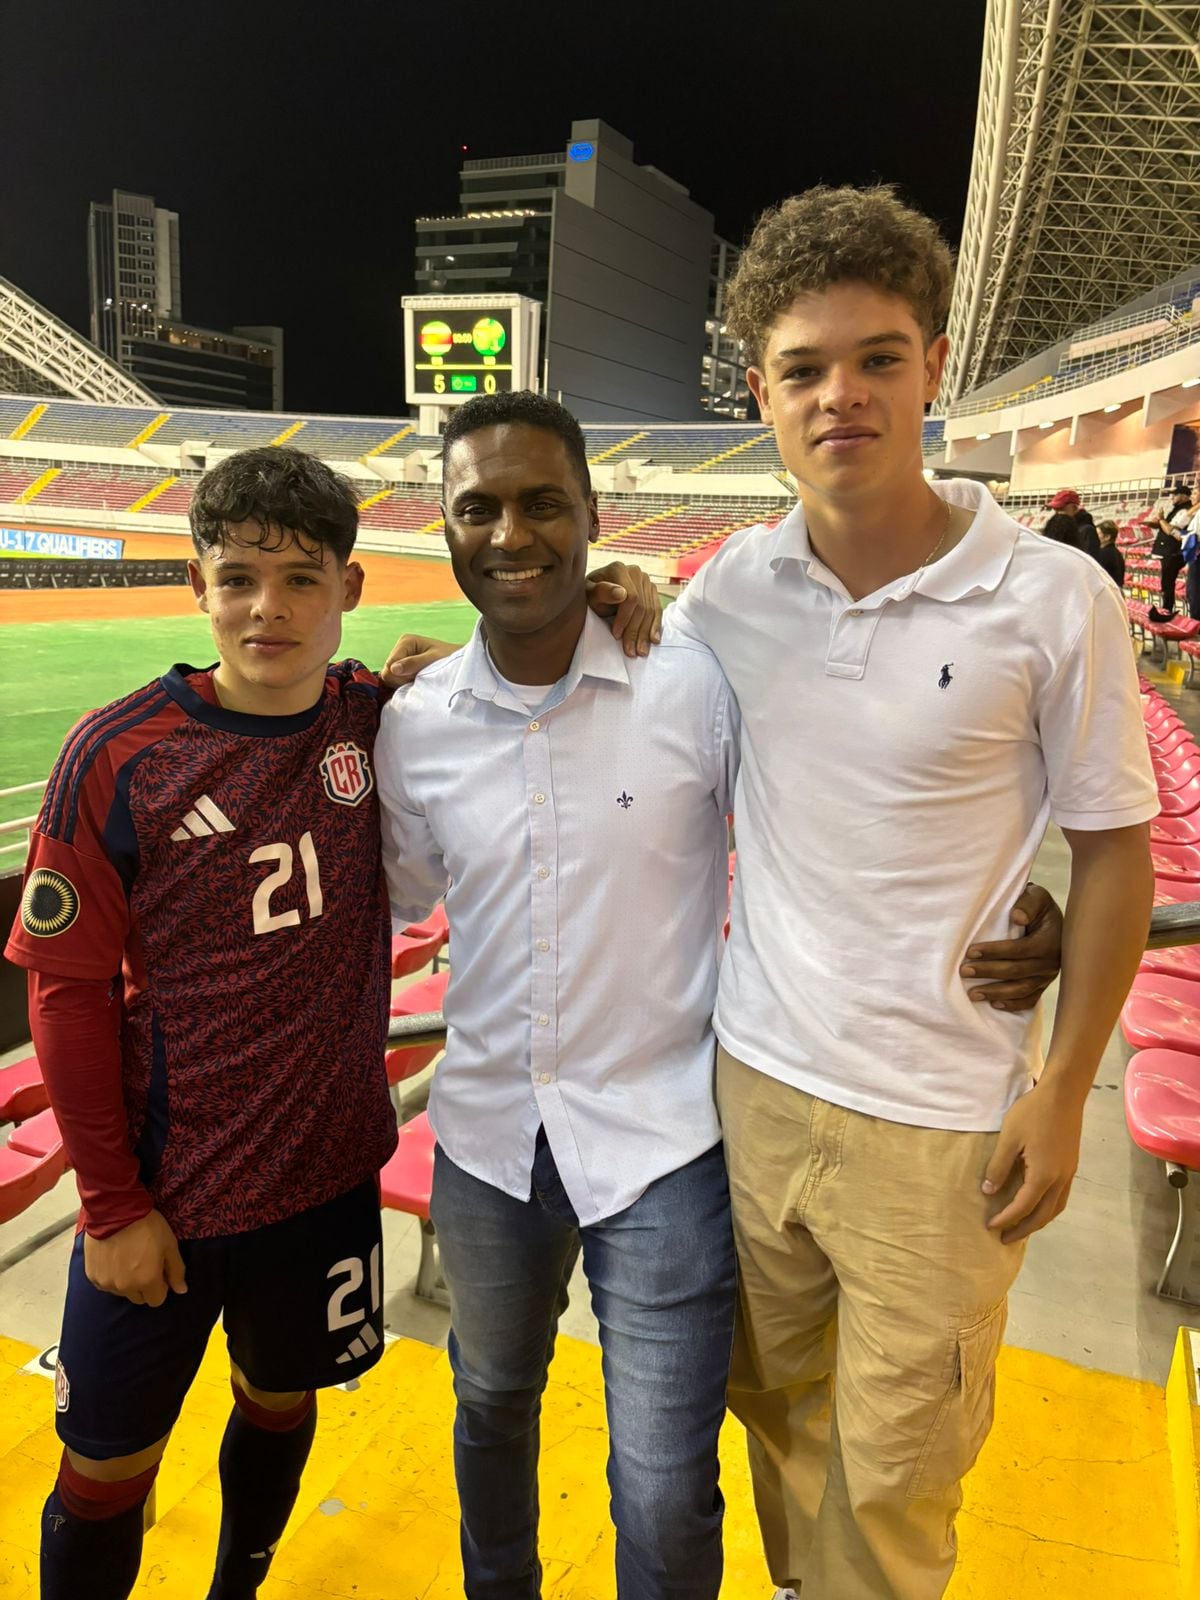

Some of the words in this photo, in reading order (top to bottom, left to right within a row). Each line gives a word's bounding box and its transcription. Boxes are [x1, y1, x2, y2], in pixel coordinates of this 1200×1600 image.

[434, 374, 446, 394] 5
[484, 374, 496, 395] 0
[0, 528, 36, 551] U-17
[37, 533, 118, 559] QUALIFIERS
[330, 754, 362, 795] CR
[248, 831, 323, 935] 21
[326, 1242, 379, 1332] 21
